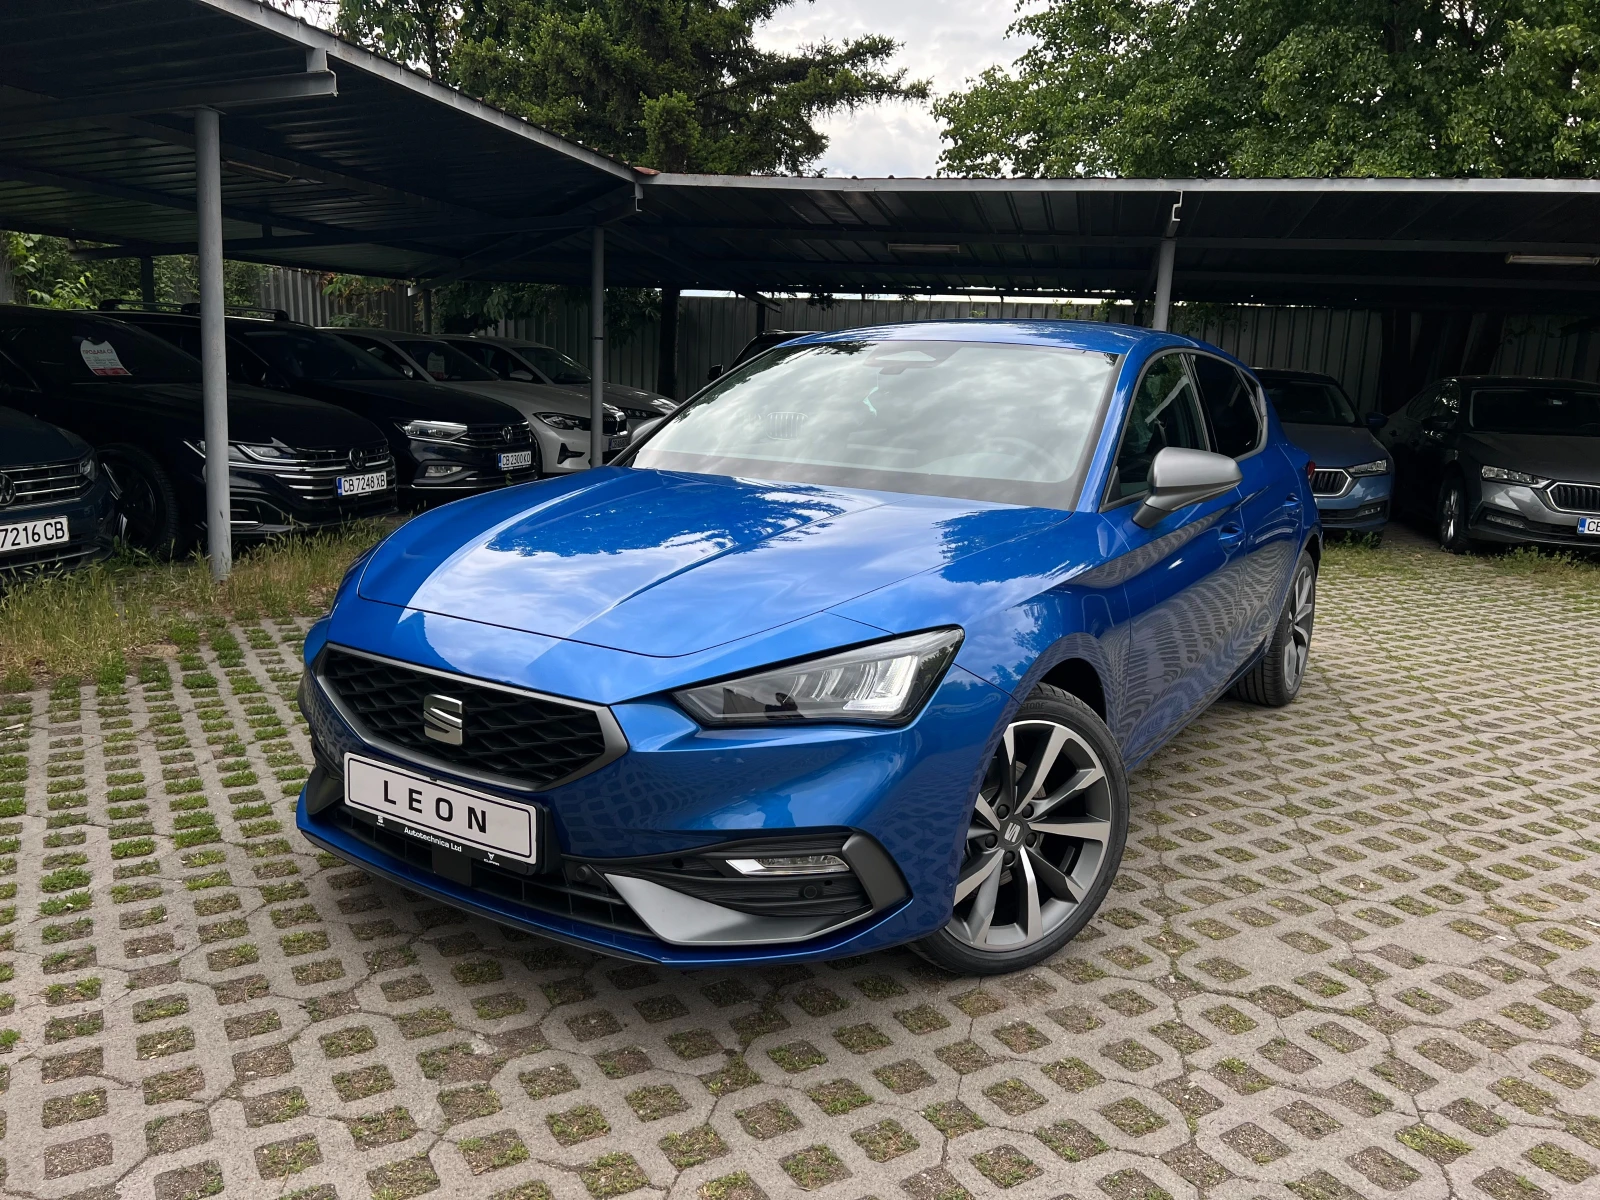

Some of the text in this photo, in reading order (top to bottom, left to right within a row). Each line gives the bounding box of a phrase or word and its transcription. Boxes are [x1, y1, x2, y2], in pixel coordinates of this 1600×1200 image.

[502, 455, 509, 466] CB
[343, 474, 386, 493] CB 7248 XB
[0, 520, 65, 548] 7216 CB
[383, 779, 487, 834] LEON
[404, 826, 462, 852] Autotechnica Ltd
